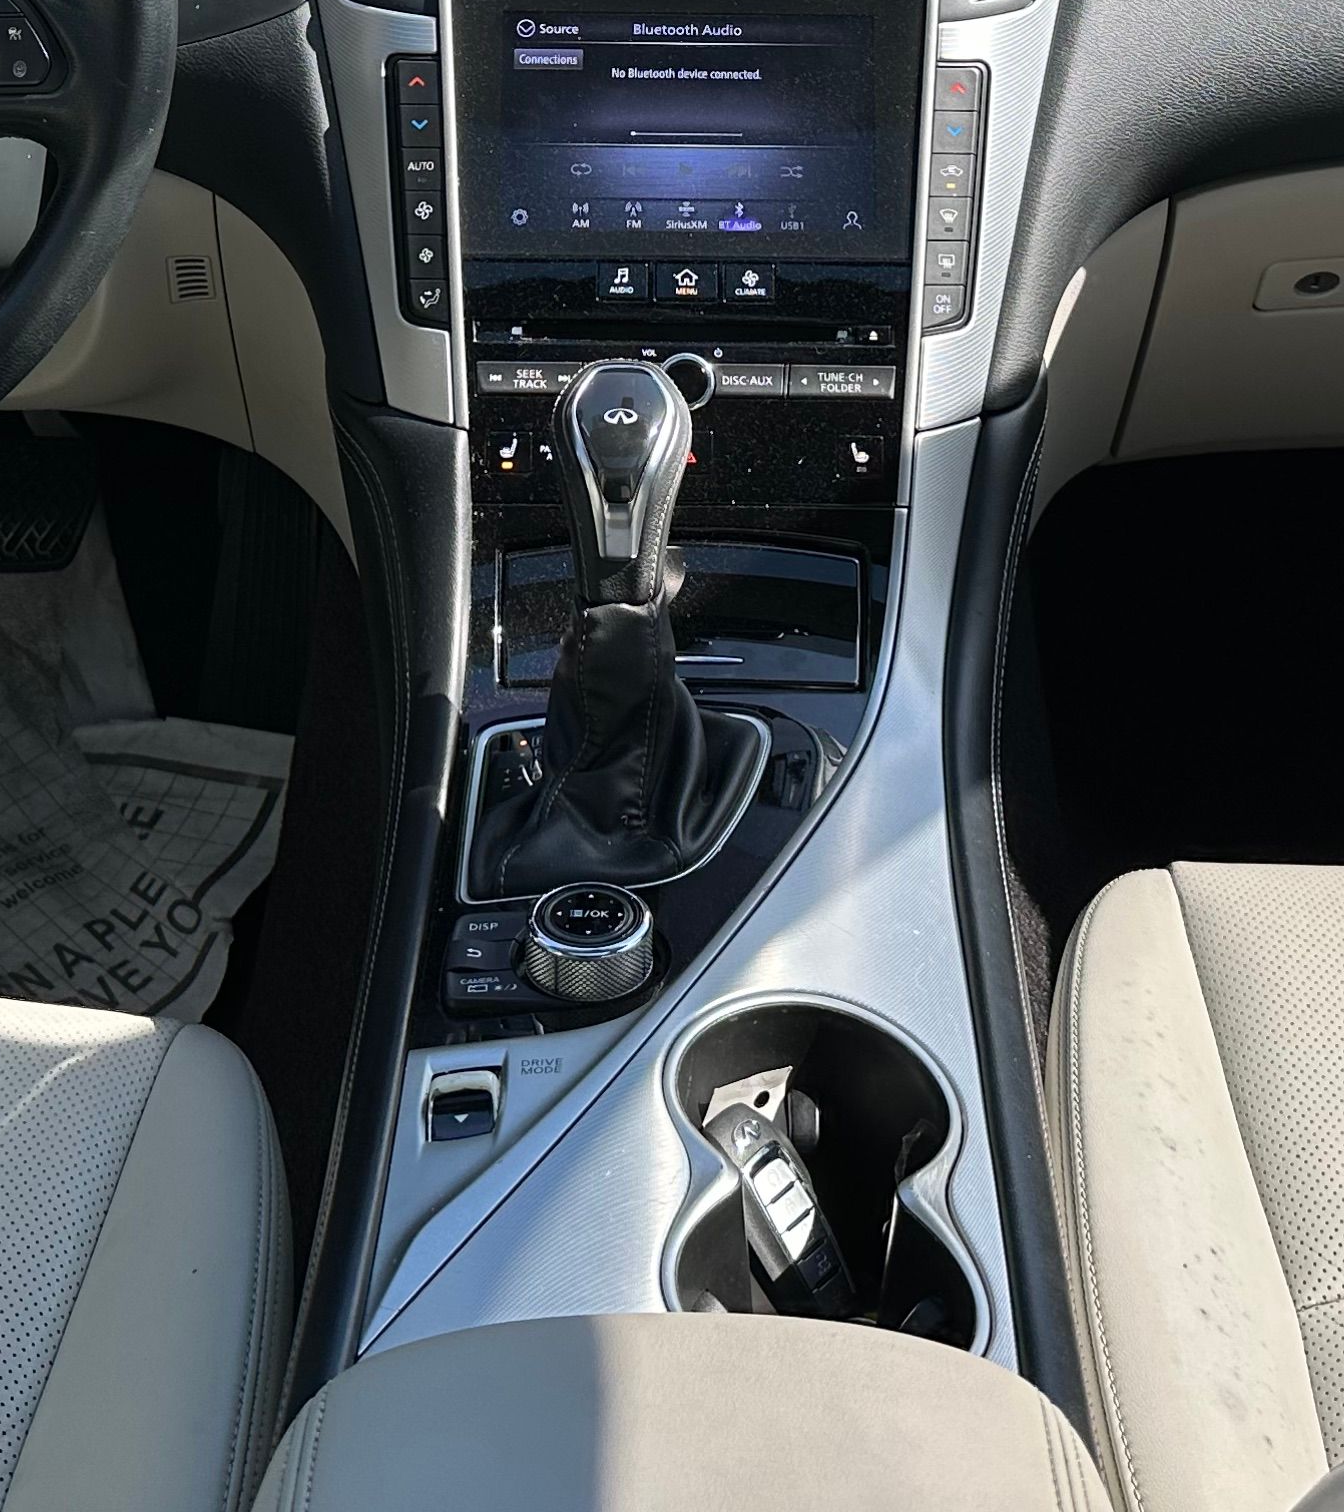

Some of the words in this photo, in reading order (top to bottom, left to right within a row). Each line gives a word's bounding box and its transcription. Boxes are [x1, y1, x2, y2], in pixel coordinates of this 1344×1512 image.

[539, 23, 580, 36] Source
[633, 23, 698, 37] Bluetooth
[701, 24, 743, 38] Audio
[518, 53, 578, 67] Connections
[611, 68, 626, 80] No
[627, 68, 675, 80] Bluetooth
[677, 68, 708, 81] device
[709, 68, 763, 81] connected.
[407, 160, 435, 171] AUTO
[571, 219, 591, 229] AM
[625, 219, 642, 229] FM
[665, 219, 708, 230] SiriusXM
[718, 220, 732, 230] BT
[733, 220, 763, 231] Audio
[609, 285, 635, 295] AUDIO
[675, 287, 698, 296] MENU
[734, 288, 767, 297] CLIMATE
[935, 294, 952, 304] ON
[933, 304, 952, 315] OFF
[641, 348, 657, 358] VOL
[516, 368, 544, 380] SEEK
[512, 378, 548, 390] TRACK
[820, 382, 864, 394] FOLDER
[17, 826, 50, 851] for
[0, 861, 86, 913] welcome
[468, 922, 499, 932] DISP
[53, 941, 97, 979] A
[459, 976, 500, 985] CAMERA
[520, 1057, 563, 1067] DRIVE
[520, 1066, 561, 1076] MODE
